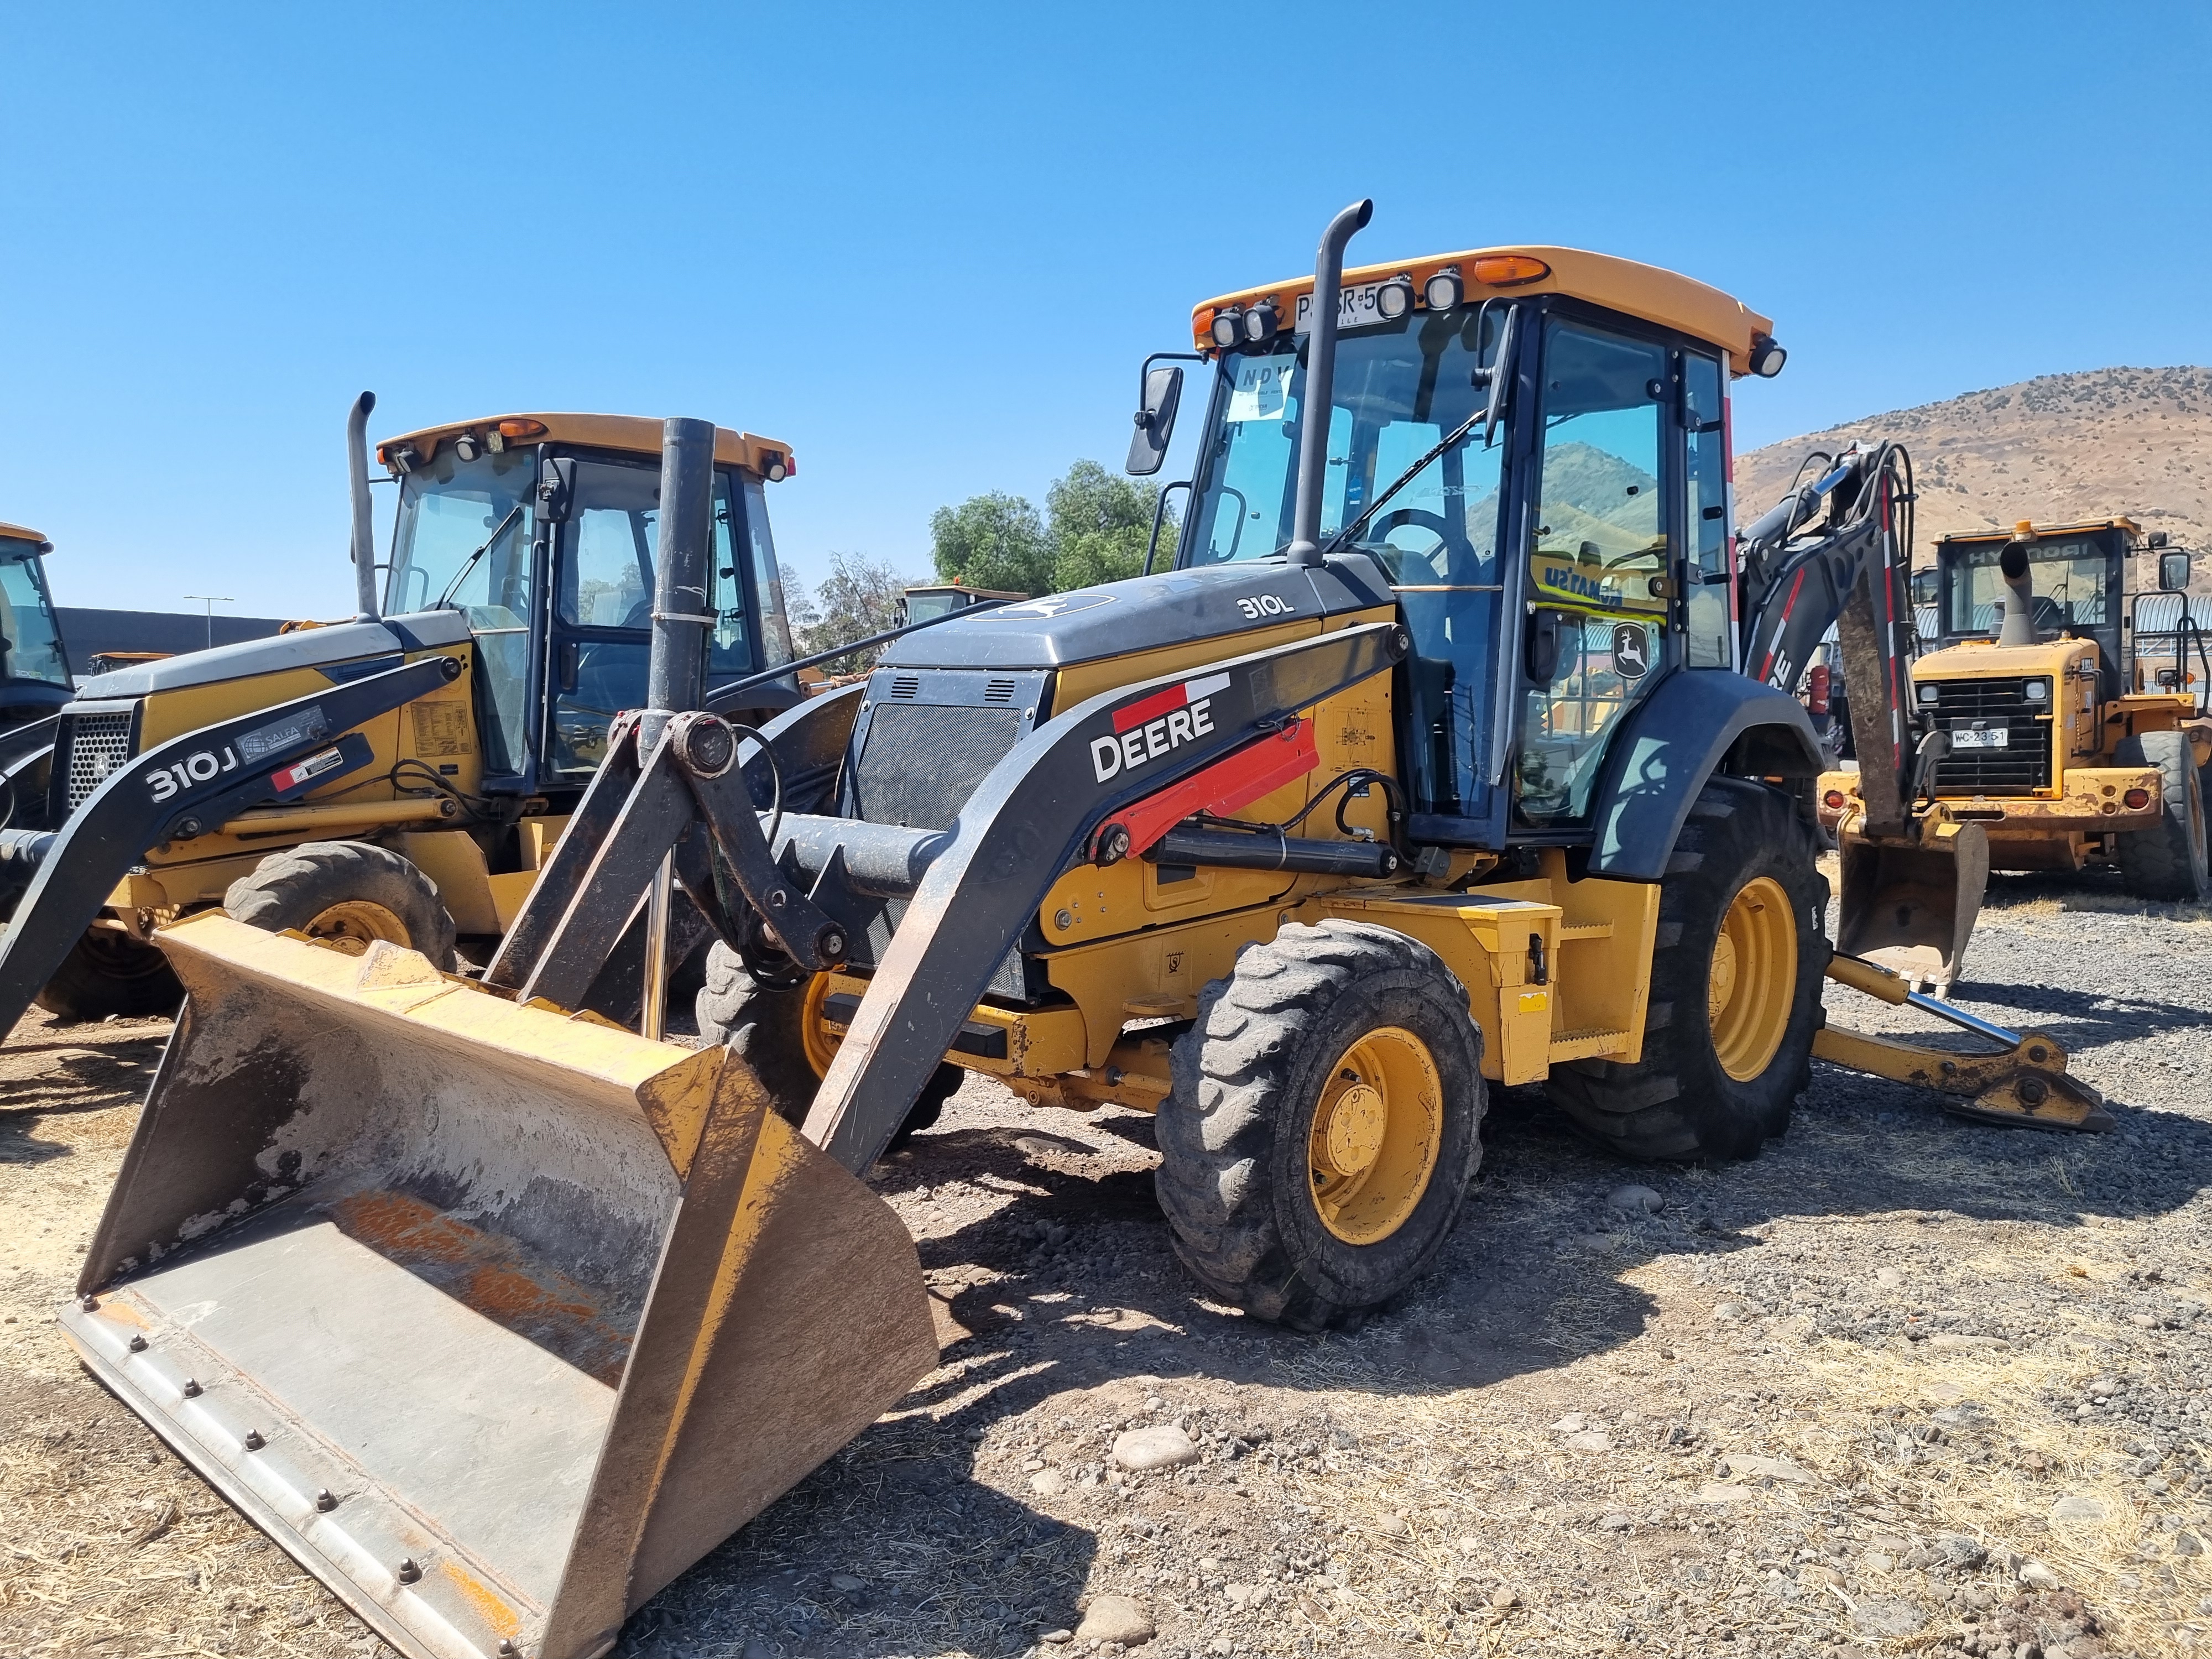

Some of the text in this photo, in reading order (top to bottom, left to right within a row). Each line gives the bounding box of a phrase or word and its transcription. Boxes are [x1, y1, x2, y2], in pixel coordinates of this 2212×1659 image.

[1969, 543, 2088, 564] HYNDAI
[1236, 594, 1295, 619] 310L
[265, 726, 299, 745] SALFA
[1090, 698, 1214, 784] DEERE
[145, 746, 237, 801] 310J
